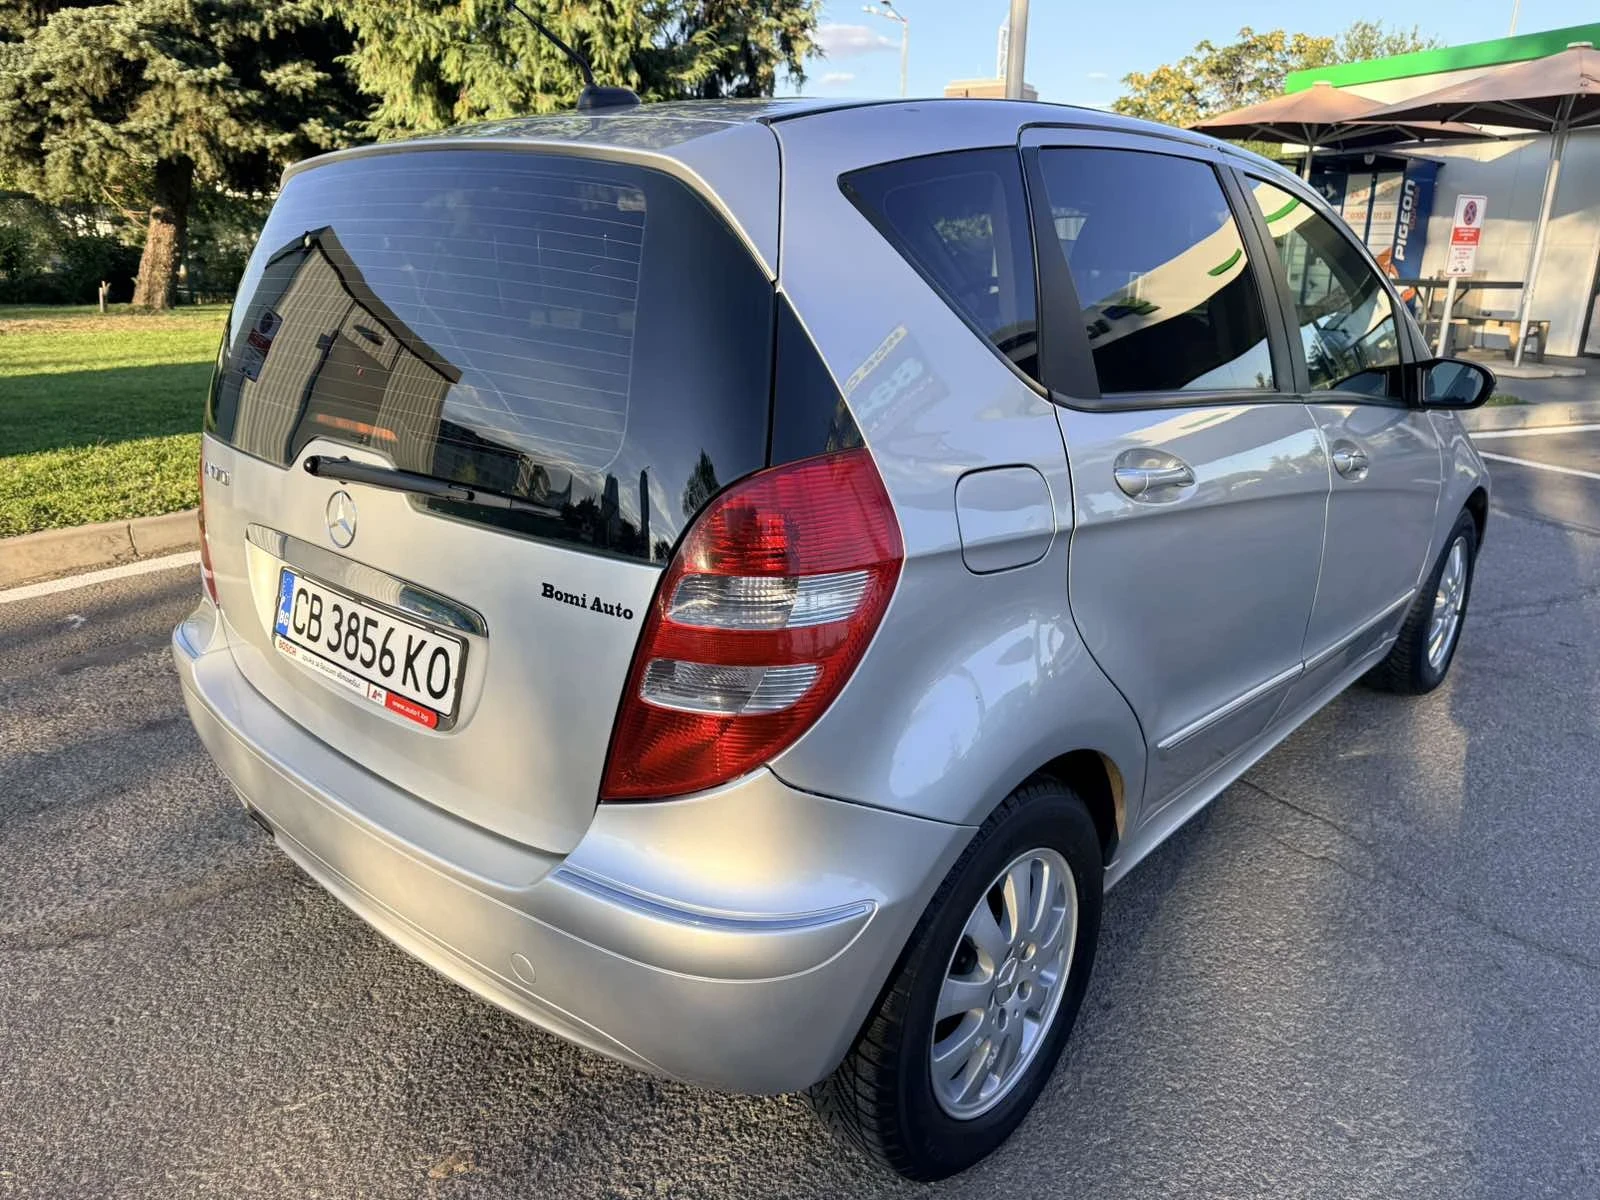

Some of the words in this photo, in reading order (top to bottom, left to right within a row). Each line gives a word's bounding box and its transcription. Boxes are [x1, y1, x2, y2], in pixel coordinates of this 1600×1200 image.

[1395, 179, 1416, 261] PIGEON
[279, 609, 289, 626] BG
[541, 582, 587, 608] Bomi
[590, 597, 634, 620] Auto
[278, 639, 297, 657] BOSCH
[292, 587, 323, 643] CB
[327, 603, 396, 678] 3856
[401, 634, 451, 700] KO
